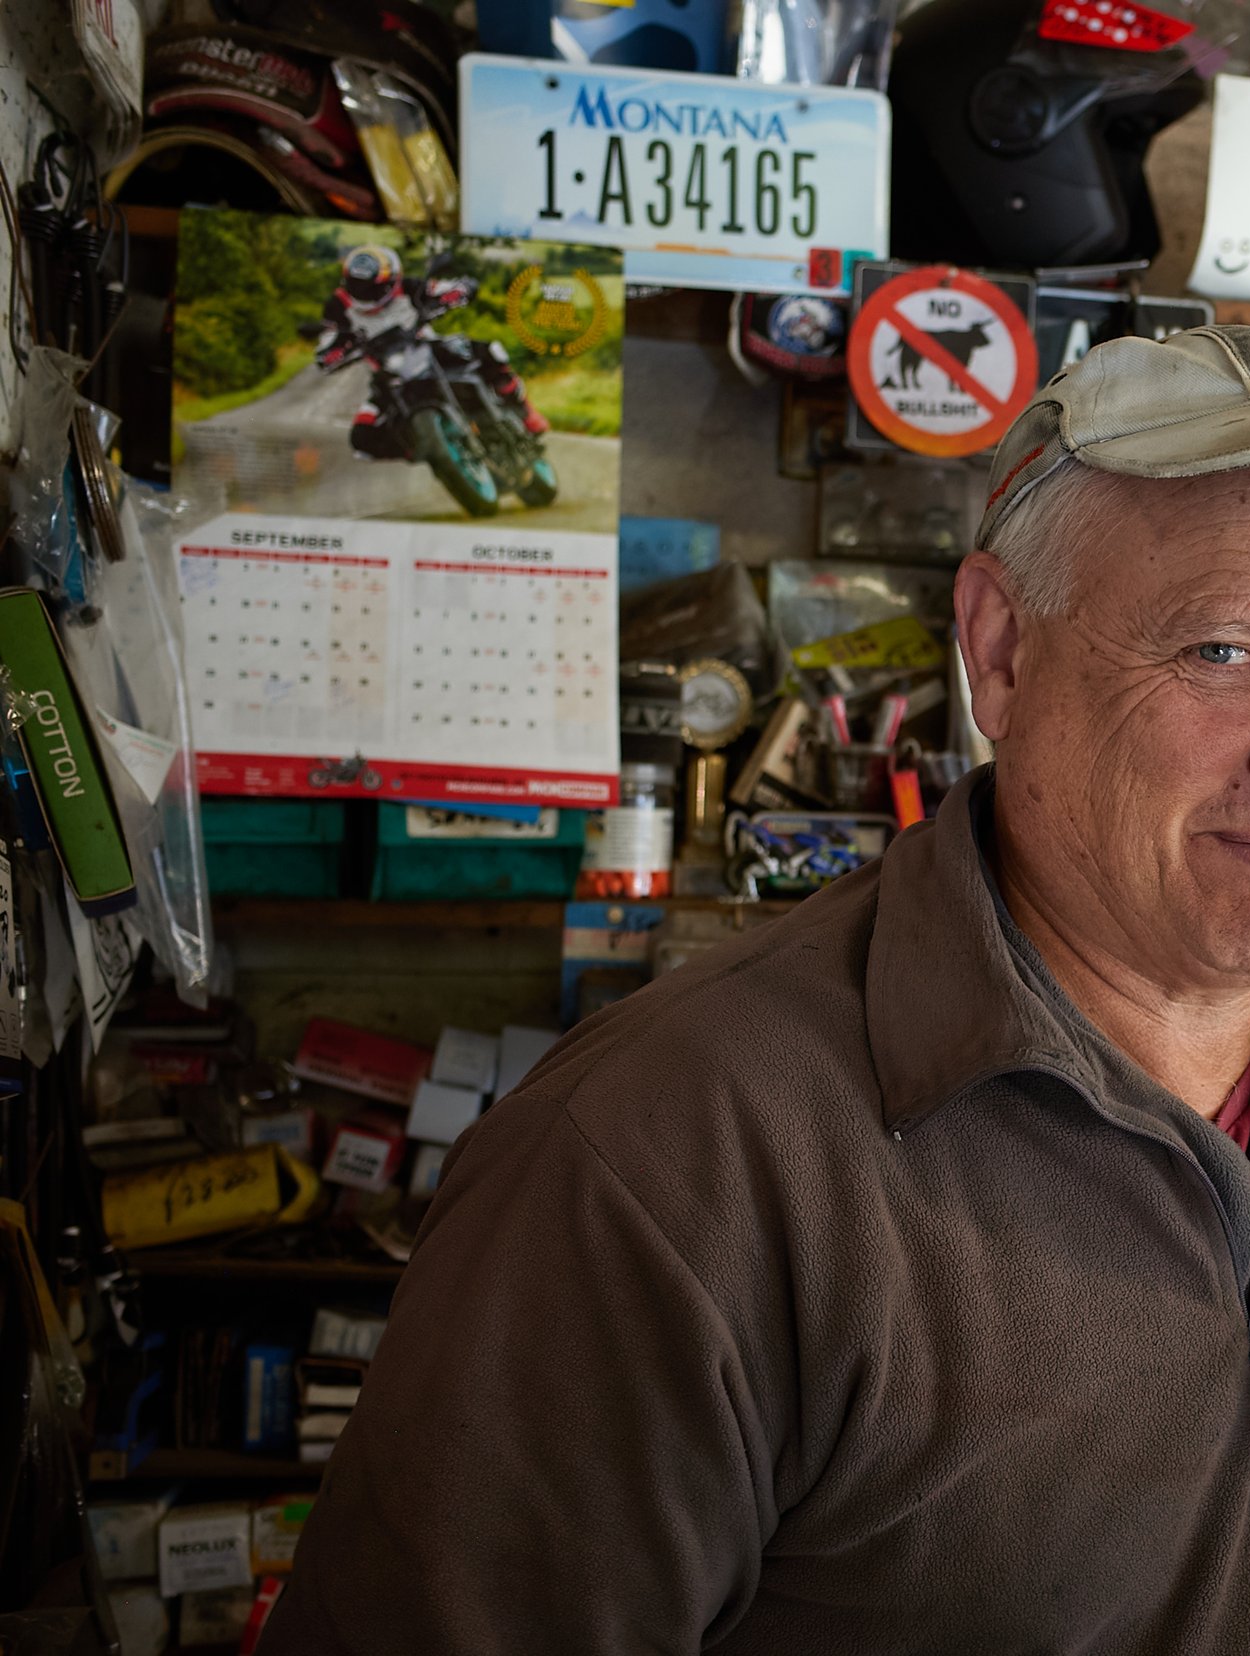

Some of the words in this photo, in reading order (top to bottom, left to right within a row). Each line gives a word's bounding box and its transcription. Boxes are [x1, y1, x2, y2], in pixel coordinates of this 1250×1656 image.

[569, 84, 788, 143] MONTANA
[928, 300, 961, 318] NO
[897, 401, 978, 417] BULLSHIT
[231, 530, 344, 550] SEPTEMBER
[473, 545, 554, 562] OCTOBER
[32, 689, 85, 799] COTTON
[168, 1537, 238, 1556] NEOLUX
